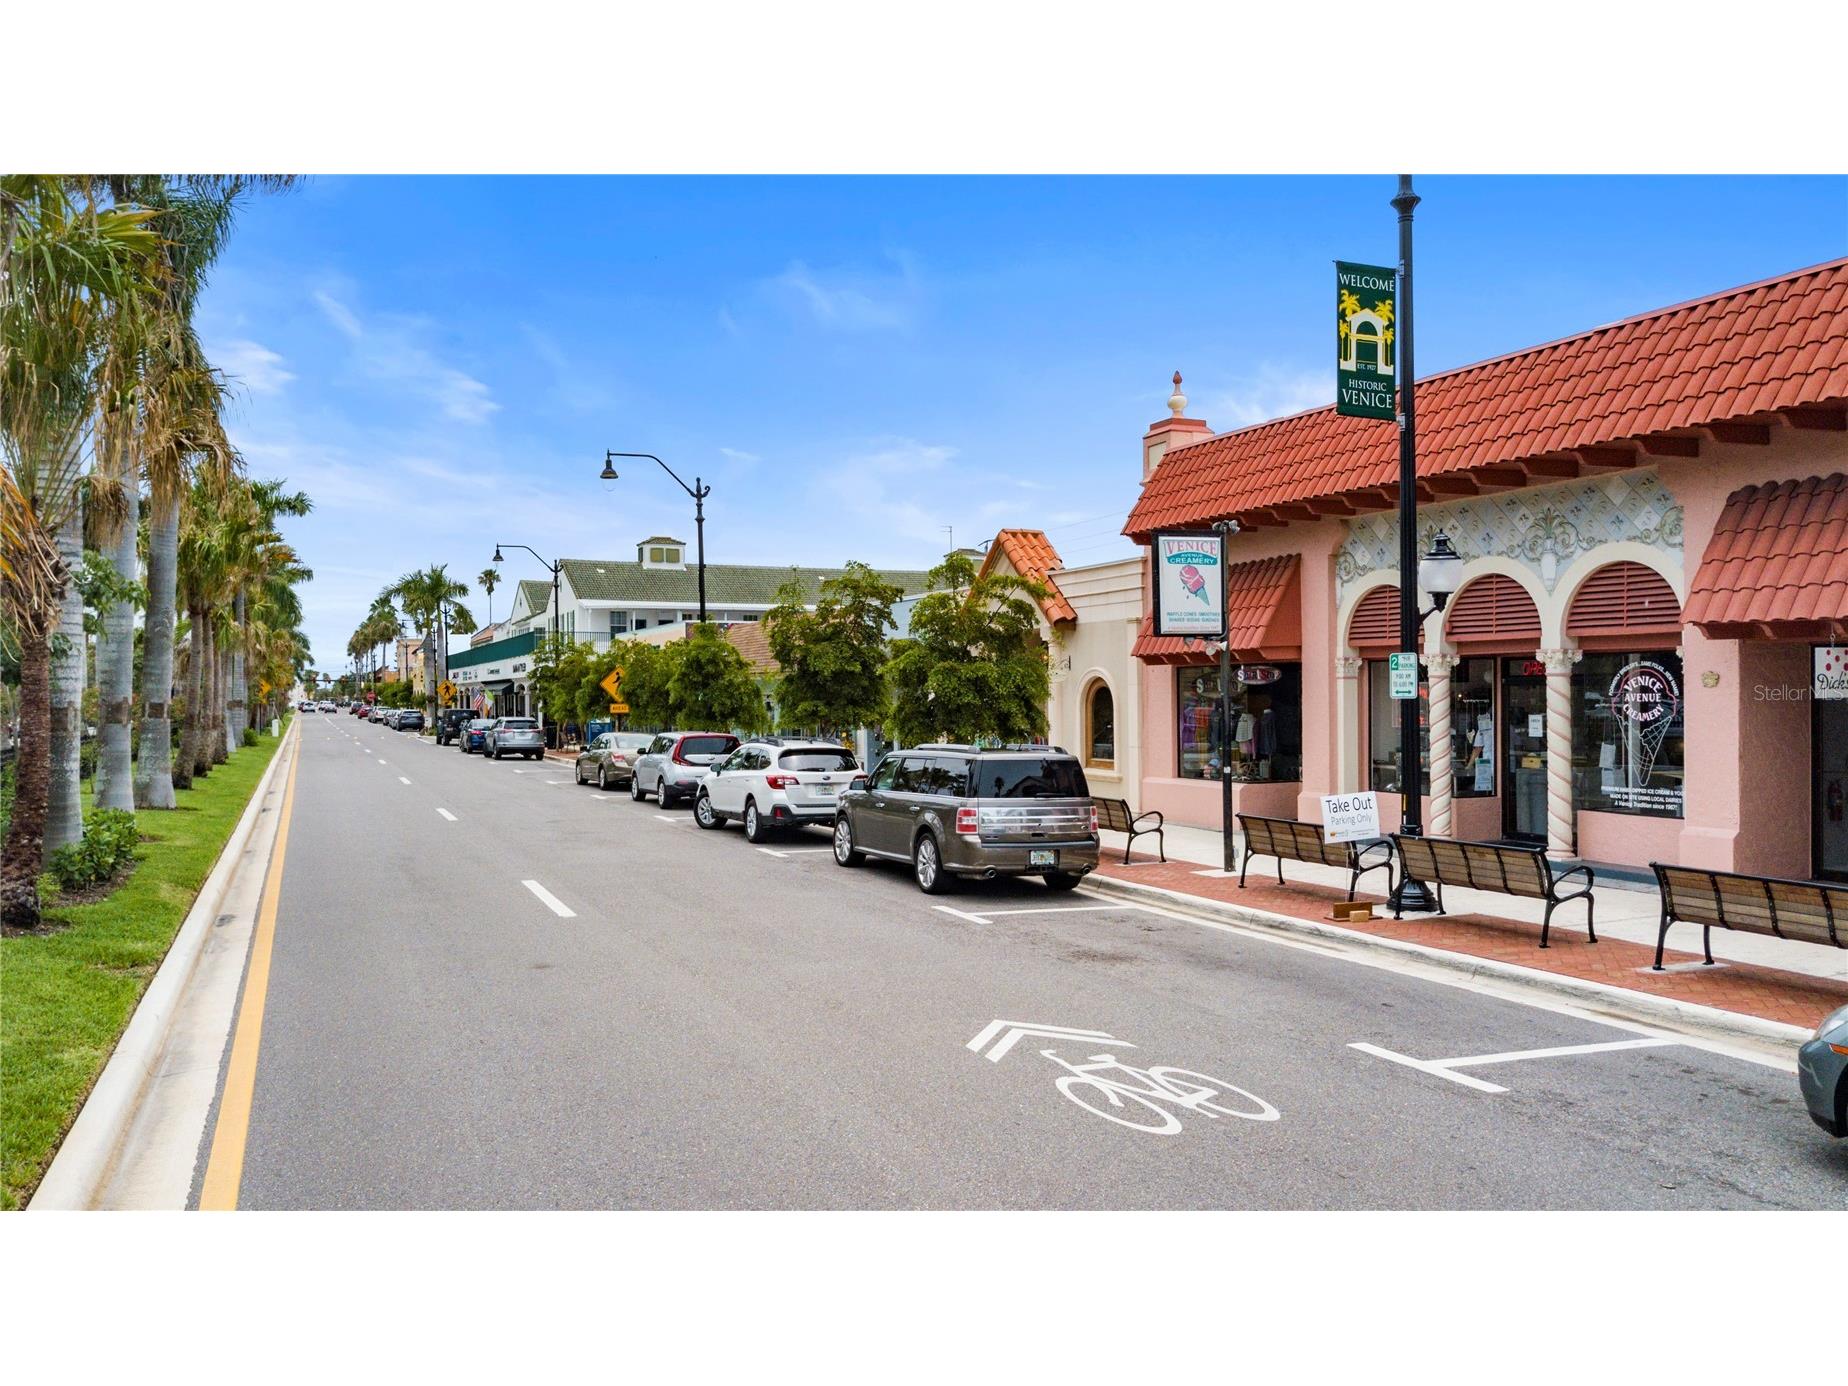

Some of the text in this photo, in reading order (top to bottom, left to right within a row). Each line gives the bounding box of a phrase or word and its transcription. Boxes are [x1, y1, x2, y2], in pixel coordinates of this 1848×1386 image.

[1339, 273, 1395, 292] WELCOME
[1348, 378, 1387, 392] HISTORIC
[1342, 388, 1393, 409] VENICE
[1167, 541, 1217, 556] VENICE
[1391, 656, 1398, 669] 2
[1523, 661, 1546, 676] OPE
[1624, 675, 1663, 693] VENICE
[1624, 693, 1662, 703] AVENUE
[1622, 703, 1665, 722] CREAMERY
[1325, 796, 1373, 814] Take Out
[1330, 814, 1372, 826] Parking Only
